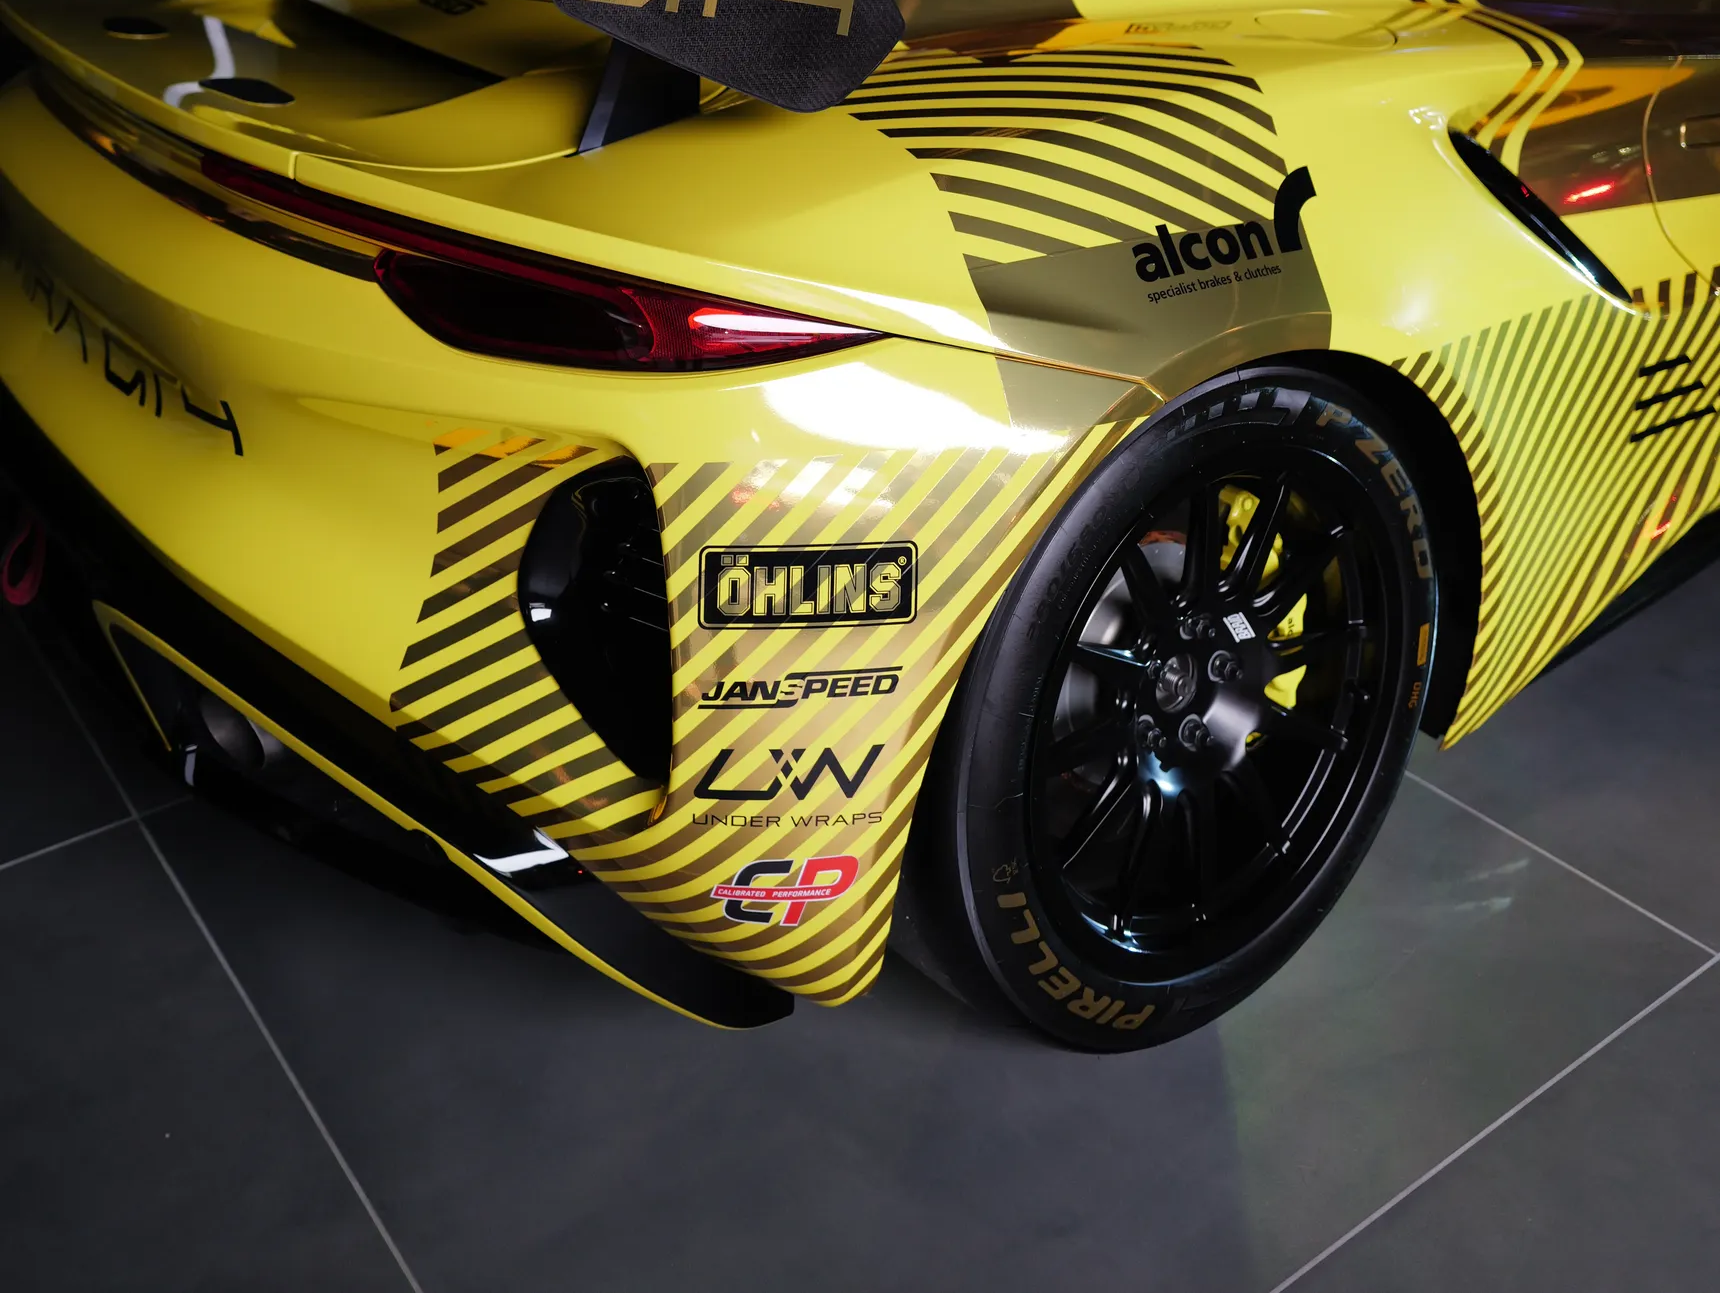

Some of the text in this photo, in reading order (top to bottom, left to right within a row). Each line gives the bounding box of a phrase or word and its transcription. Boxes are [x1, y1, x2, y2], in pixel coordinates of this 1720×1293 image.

[1132, 220, 1275, 283] alcon
[1147, 263, 1282, 304] specialist brakes & clutches
[102, 328, 244, 457] GT4
[1315, 401, 1435, 580] P ZERO
[701, 673, 900, 702] JANSPEED
[692, 811, 883, 828] UNDER WRAPS
[717, 888, 832, 898] CALIBRATED PERFORMANCE
[996, 891, 1157, 1031] PIRELLI
